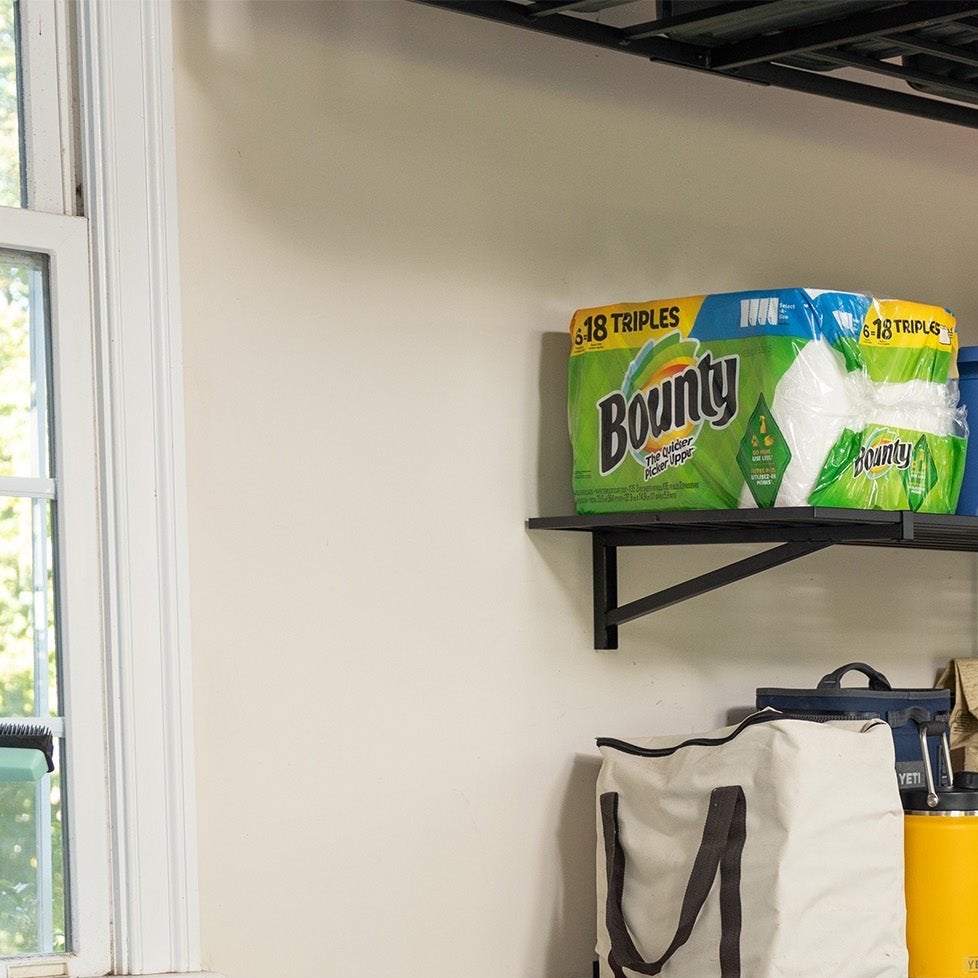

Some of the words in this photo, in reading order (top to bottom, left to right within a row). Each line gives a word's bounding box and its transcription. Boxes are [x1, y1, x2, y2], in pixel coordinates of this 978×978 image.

[610, 306, 680, 333] TRIPLES
[894, 319, 940, 336] TRIPLES
[598, 352, 738, 474] Bounty
[646, 453, 661, 467] The
[662, 437, 693, 458] Quicker
[854, 439, 911, 478] Bounty
[645, 459, 669, 480] Picker
[898, 772, 921, 785] YETI
